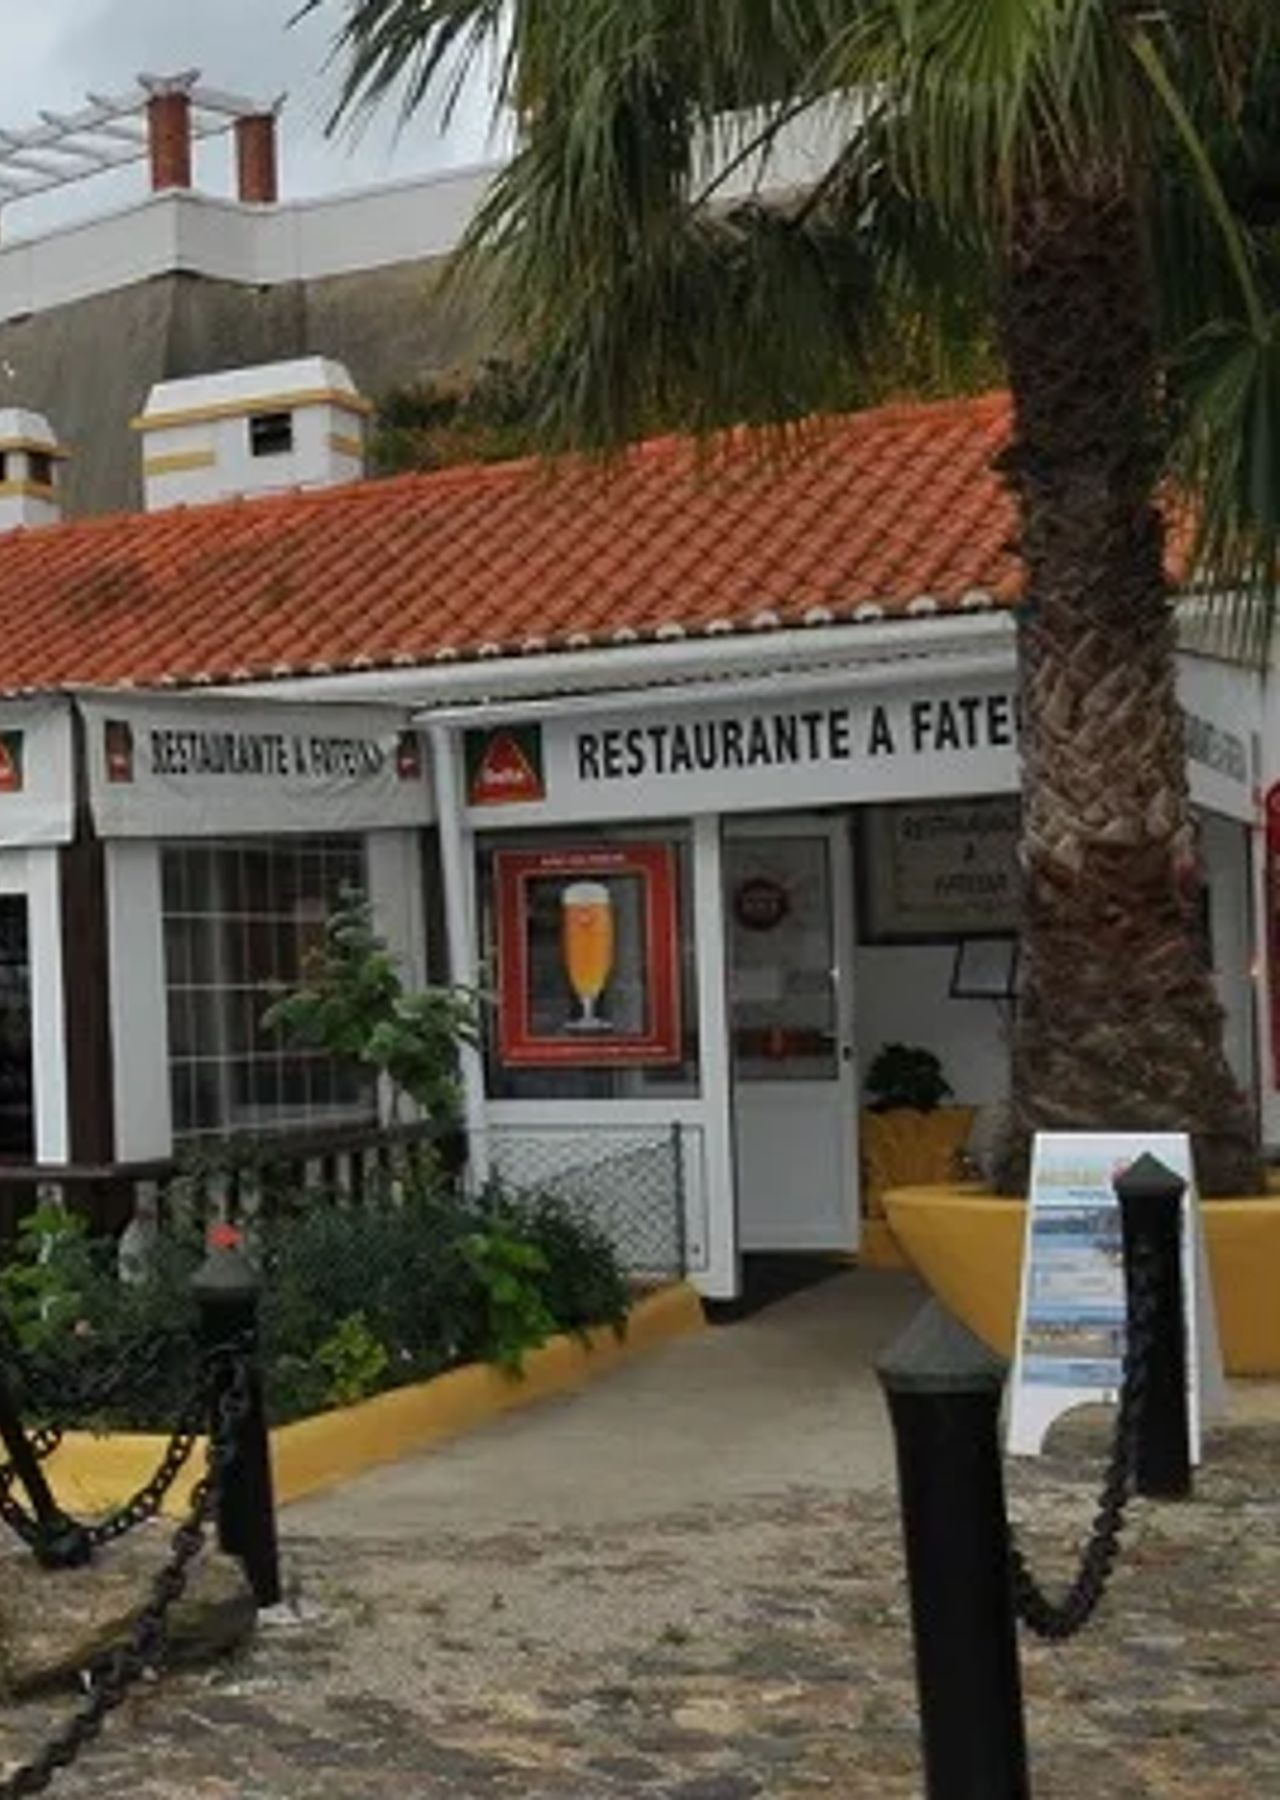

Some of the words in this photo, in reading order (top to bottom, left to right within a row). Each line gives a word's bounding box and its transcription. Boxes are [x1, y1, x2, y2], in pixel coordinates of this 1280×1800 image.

[151, 730, 288, 775] RESTAURANTE
[295, 735, 308, 774] A
[577, 706, 850, 779] RESTAURANTE
[869, 704, 895, 755] A
